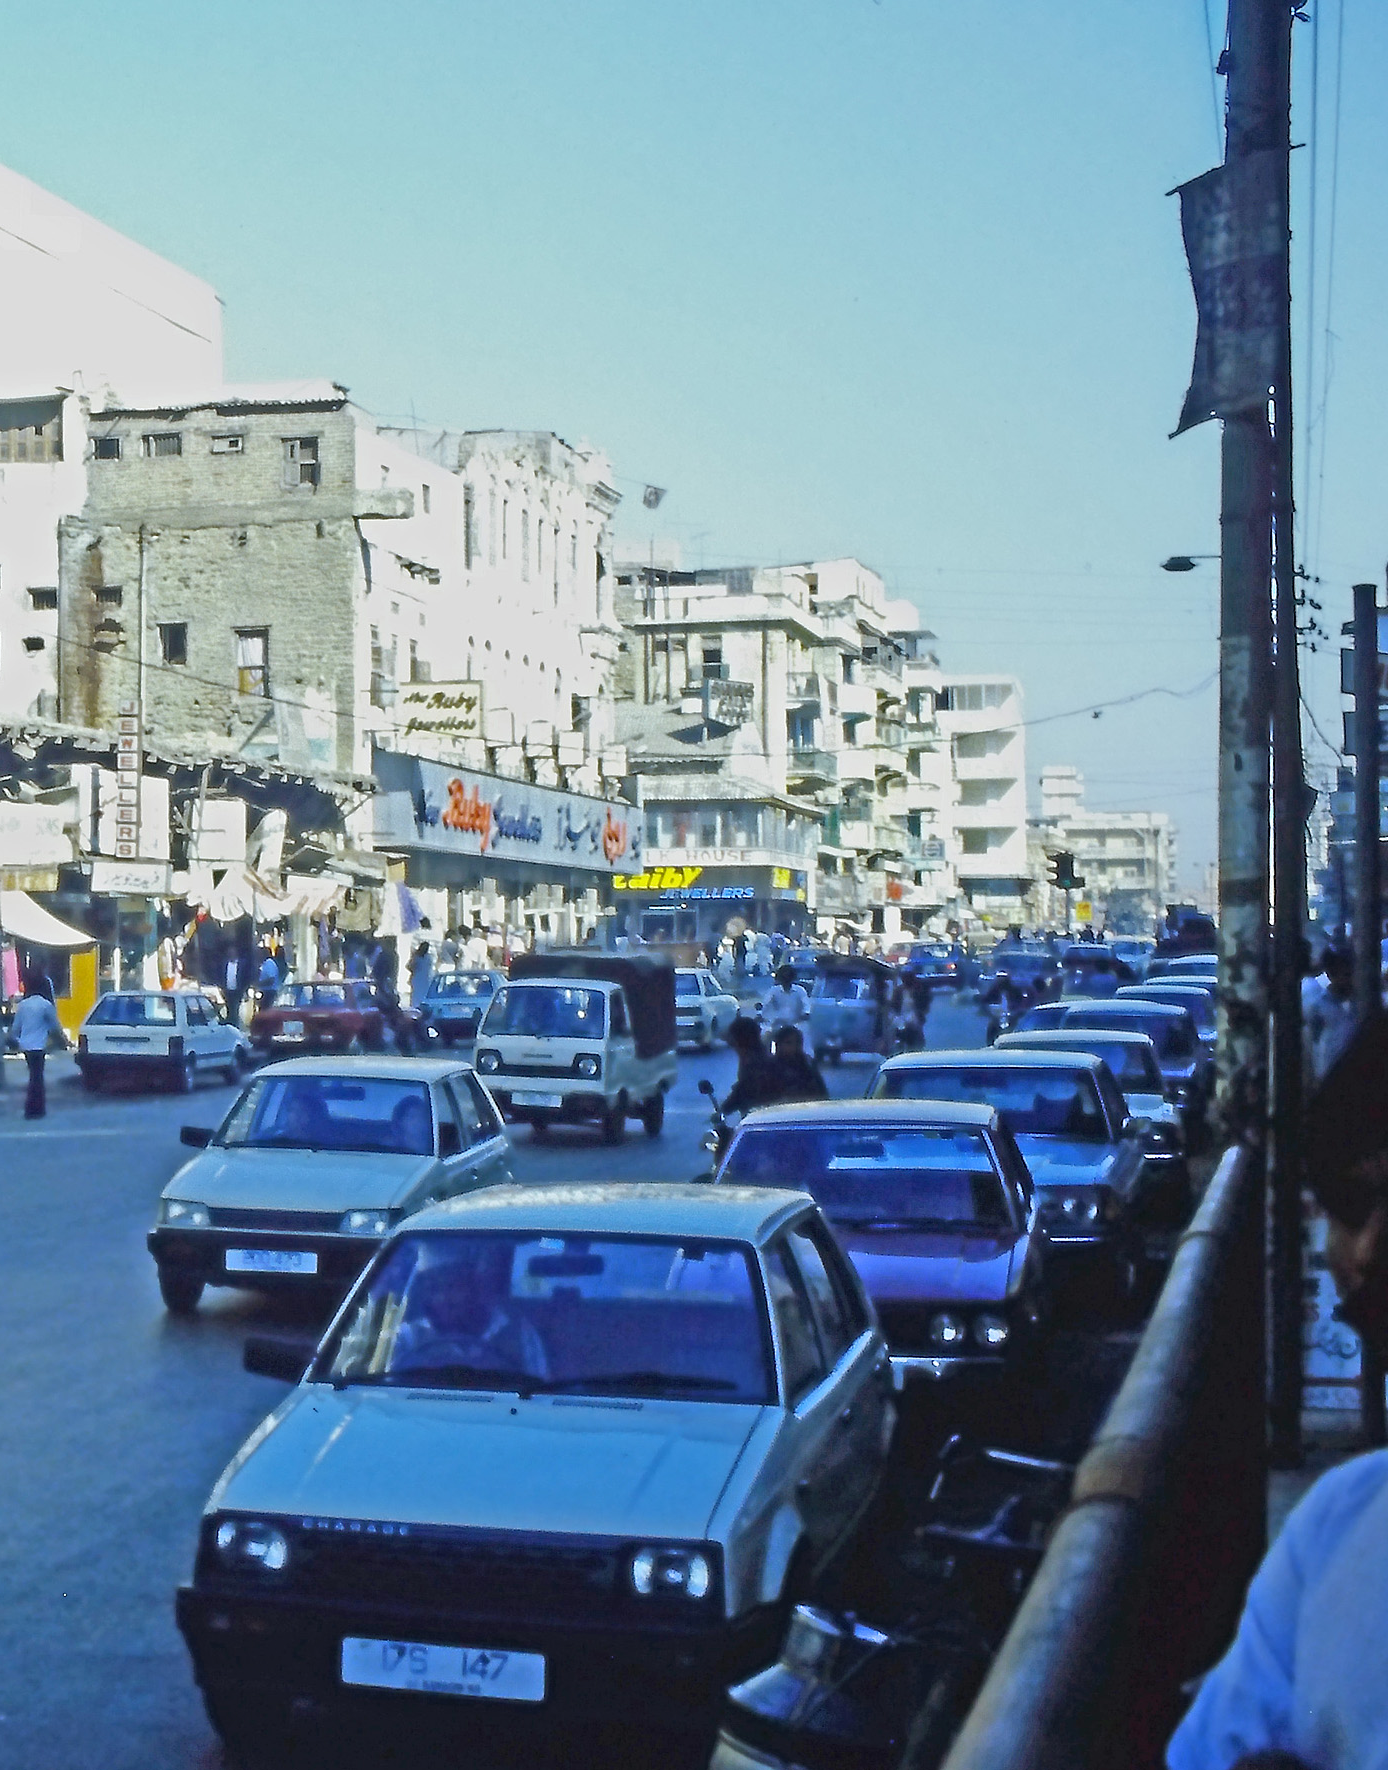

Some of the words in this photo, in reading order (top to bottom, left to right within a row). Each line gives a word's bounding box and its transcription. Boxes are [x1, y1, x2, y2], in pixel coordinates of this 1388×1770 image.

[118, 700, 136, 857] JEWELLERS
[685, 849, 752, 862] HOUSE
[659, 887, 755, 899] JEWELLERS
